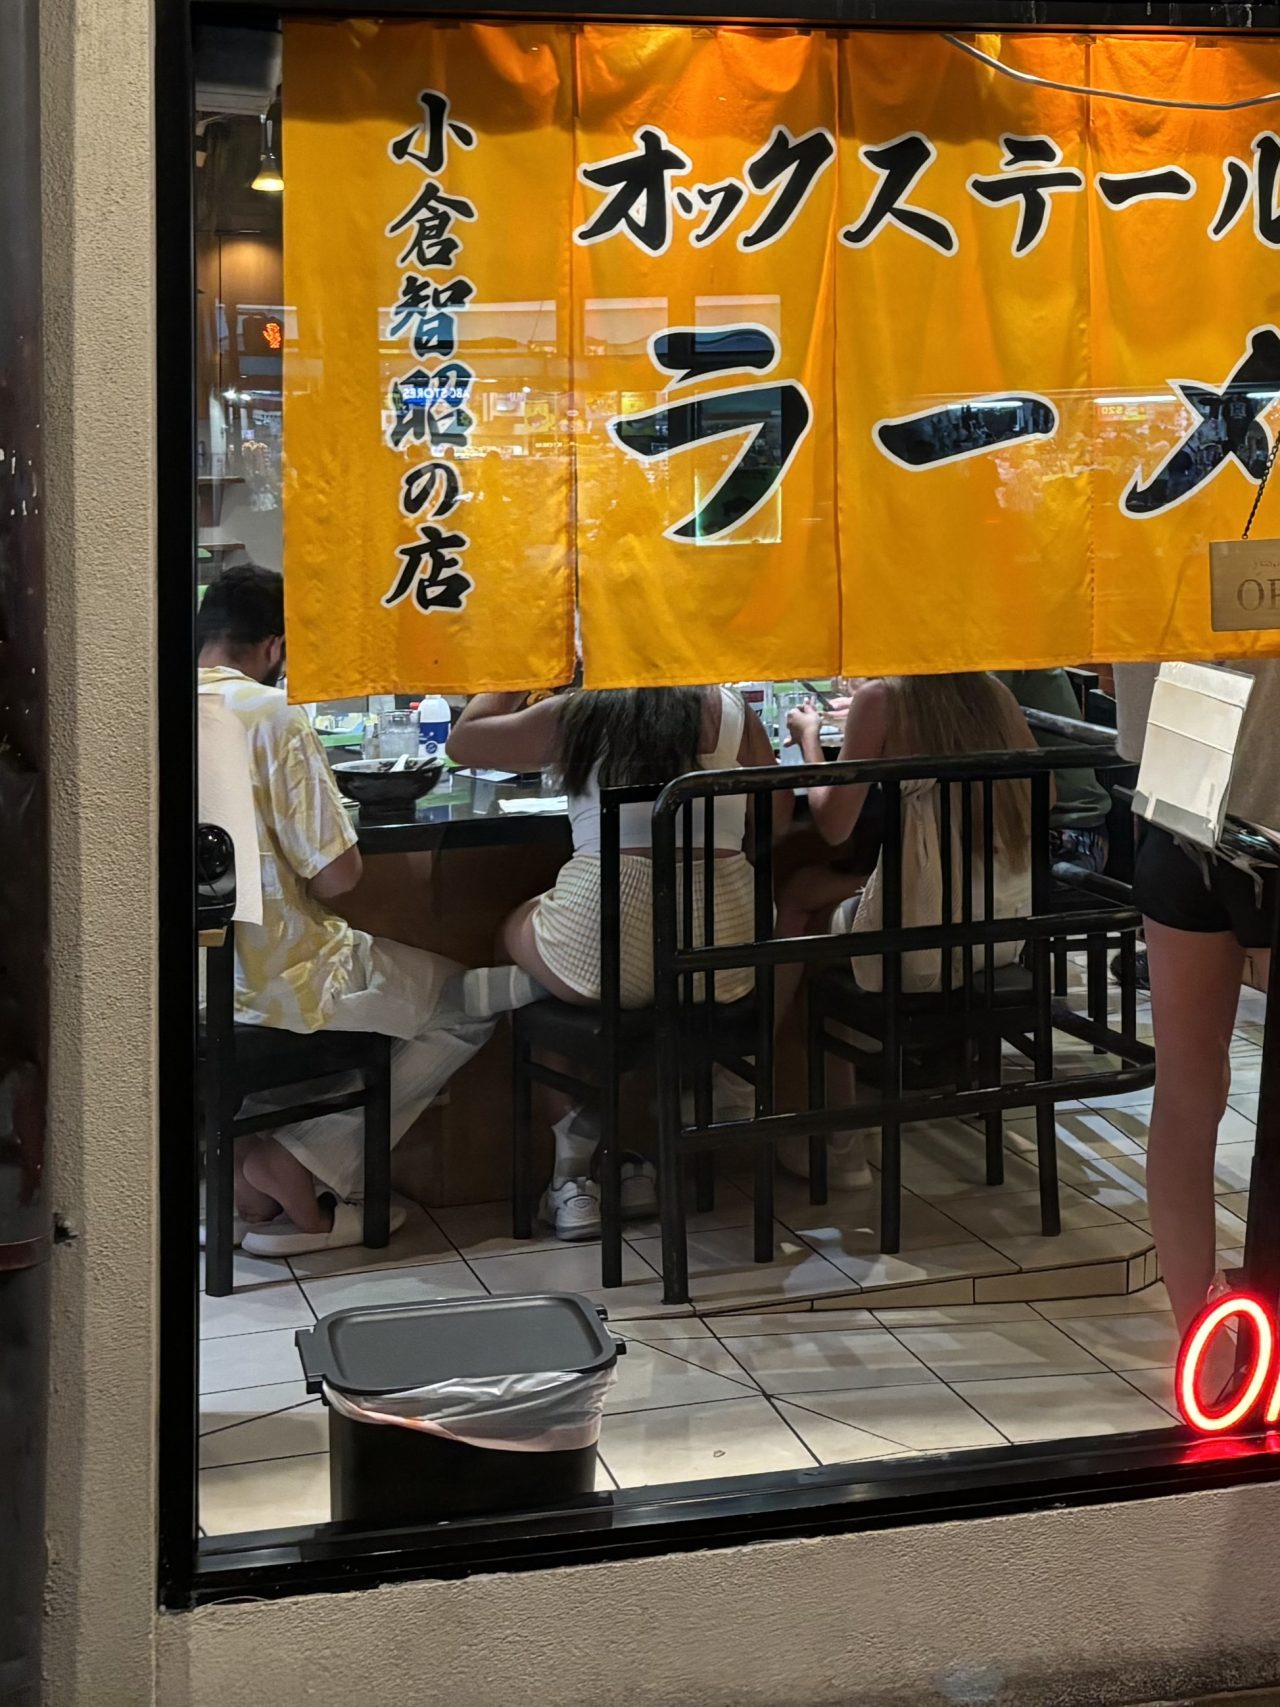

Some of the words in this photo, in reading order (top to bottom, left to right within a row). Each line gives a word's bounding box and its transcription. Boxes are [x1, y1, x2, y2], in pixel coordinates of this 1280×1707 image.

[382, 91, 477, 612] 小倉智昭の店
